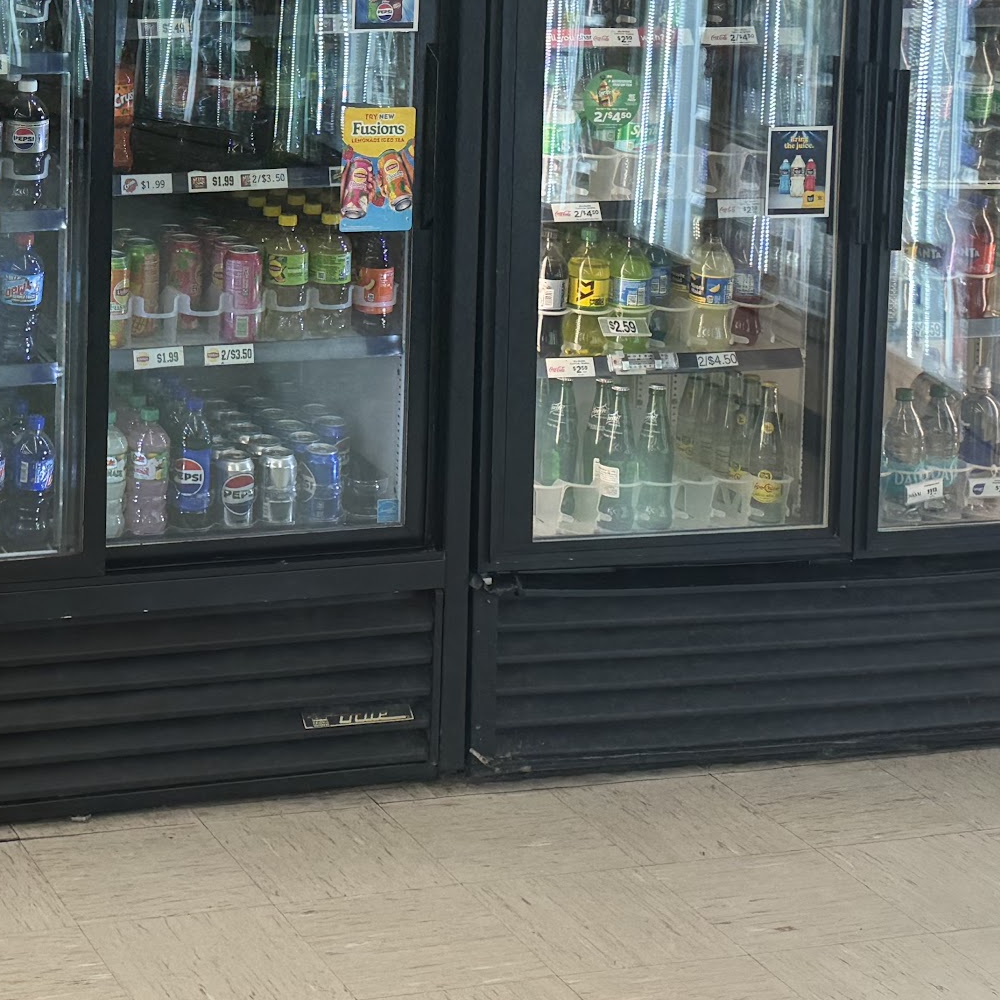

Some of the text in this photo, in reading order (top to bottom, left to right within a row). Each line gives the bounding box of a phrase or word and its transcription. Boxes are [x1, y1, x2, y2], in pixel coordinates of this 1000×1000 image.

[352, 122, 405, 135] Fusions
[13, 135, 35, 143] PEPSI
[141, 180, 165, 190] $1.99
[212, 176, 234, 187] $1.99
[252, 174, 285, 184] 2/$3.50
[608, 320, 637, 333] $2.59
[156, 351, 179, 363] $1.99
[221, 349, 253, 361] 2/$3.50
[698, 353, 738, 367] 2/$4.50
